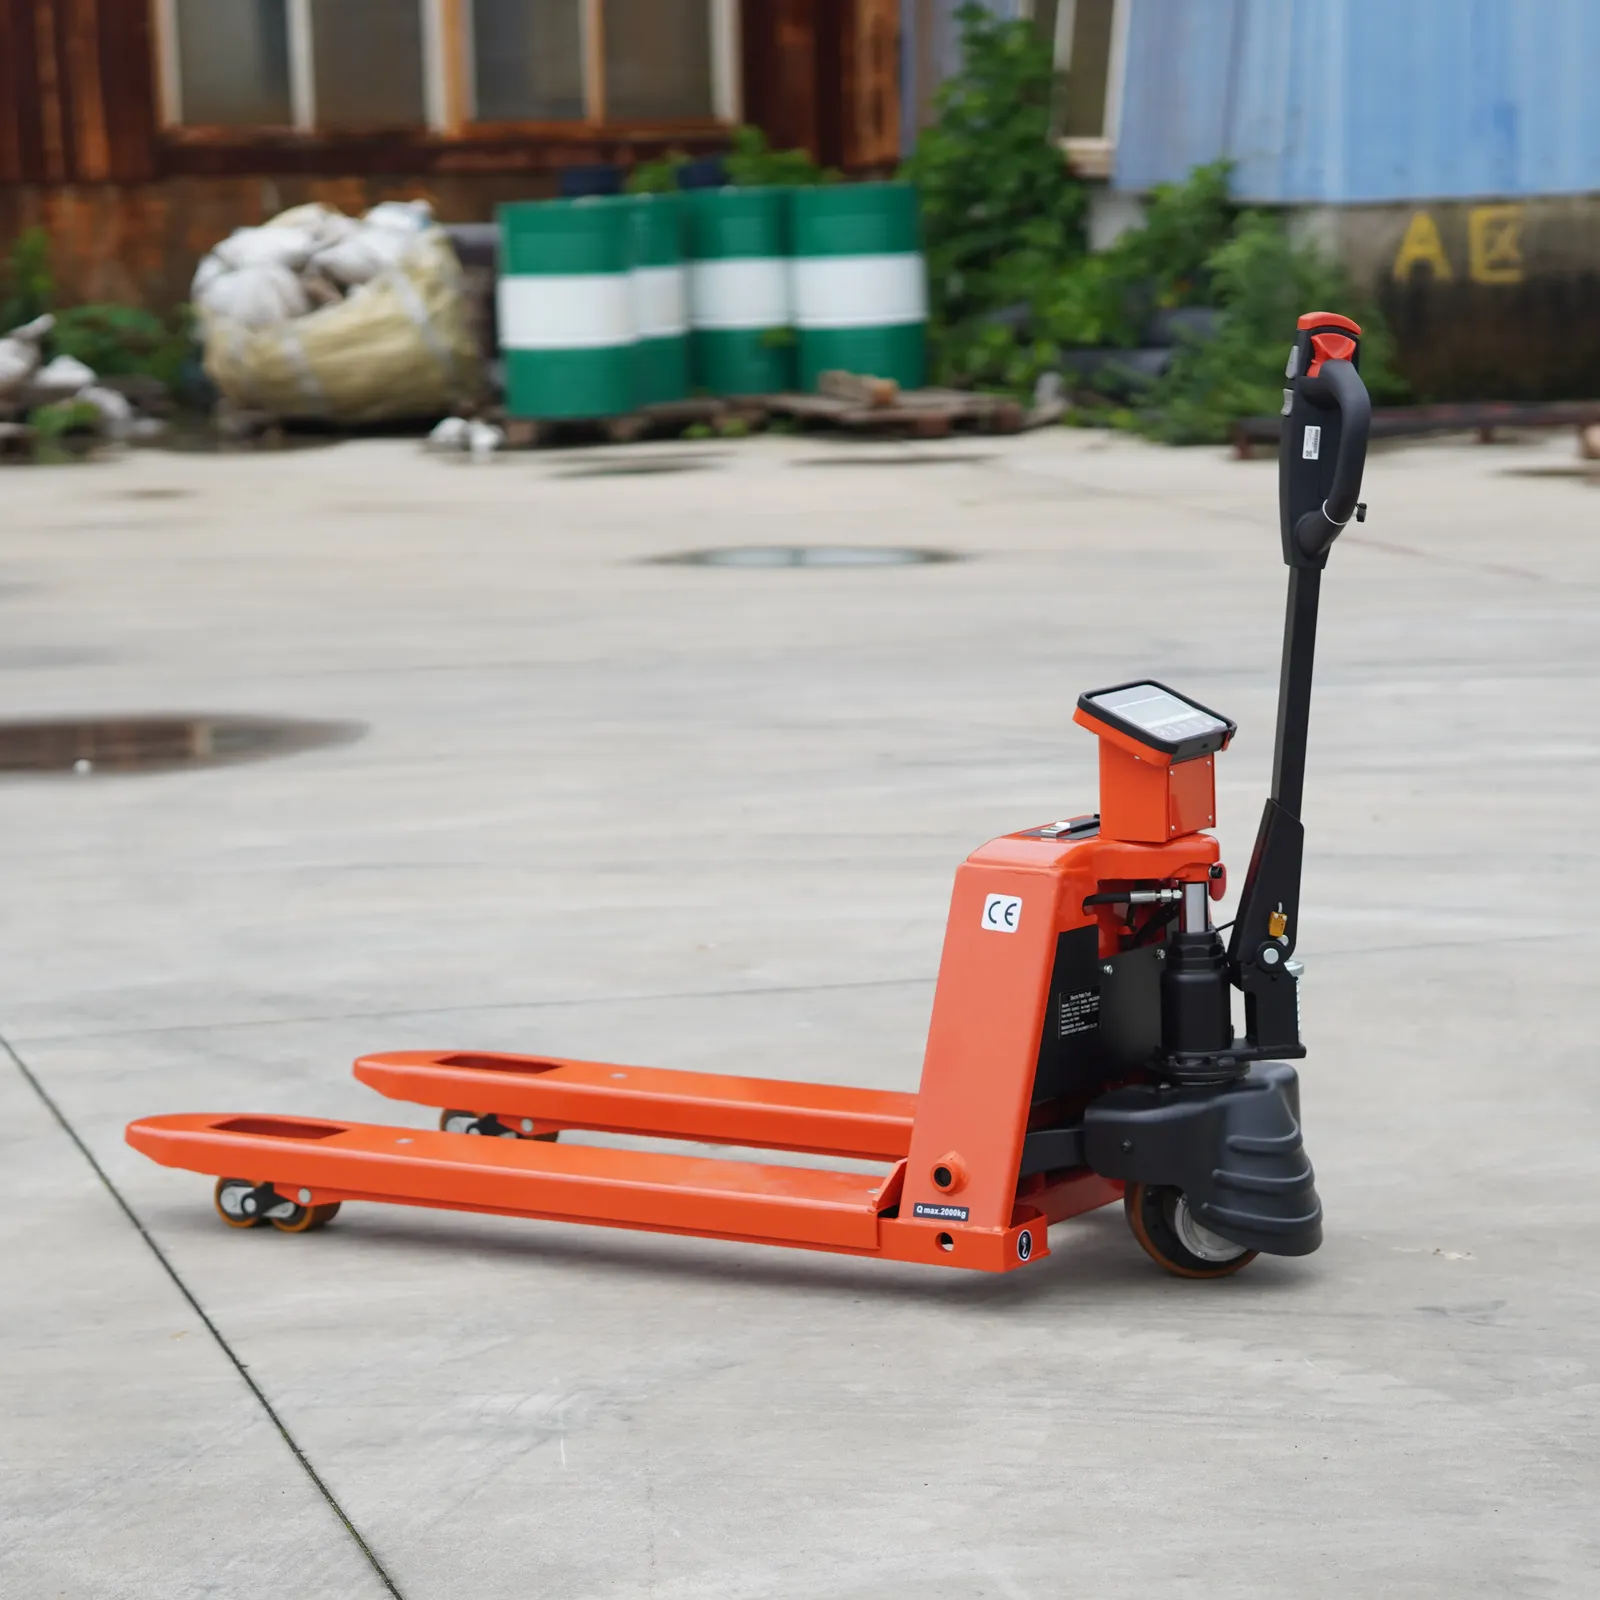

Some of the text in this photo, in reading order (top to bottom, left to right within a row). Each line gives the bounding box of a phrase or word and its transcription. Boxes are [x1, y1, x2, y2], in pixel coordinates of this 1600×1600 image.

[988, 900, 1017, 926] CE
[916, 1205, 966, 1219] Q max.2000kg
